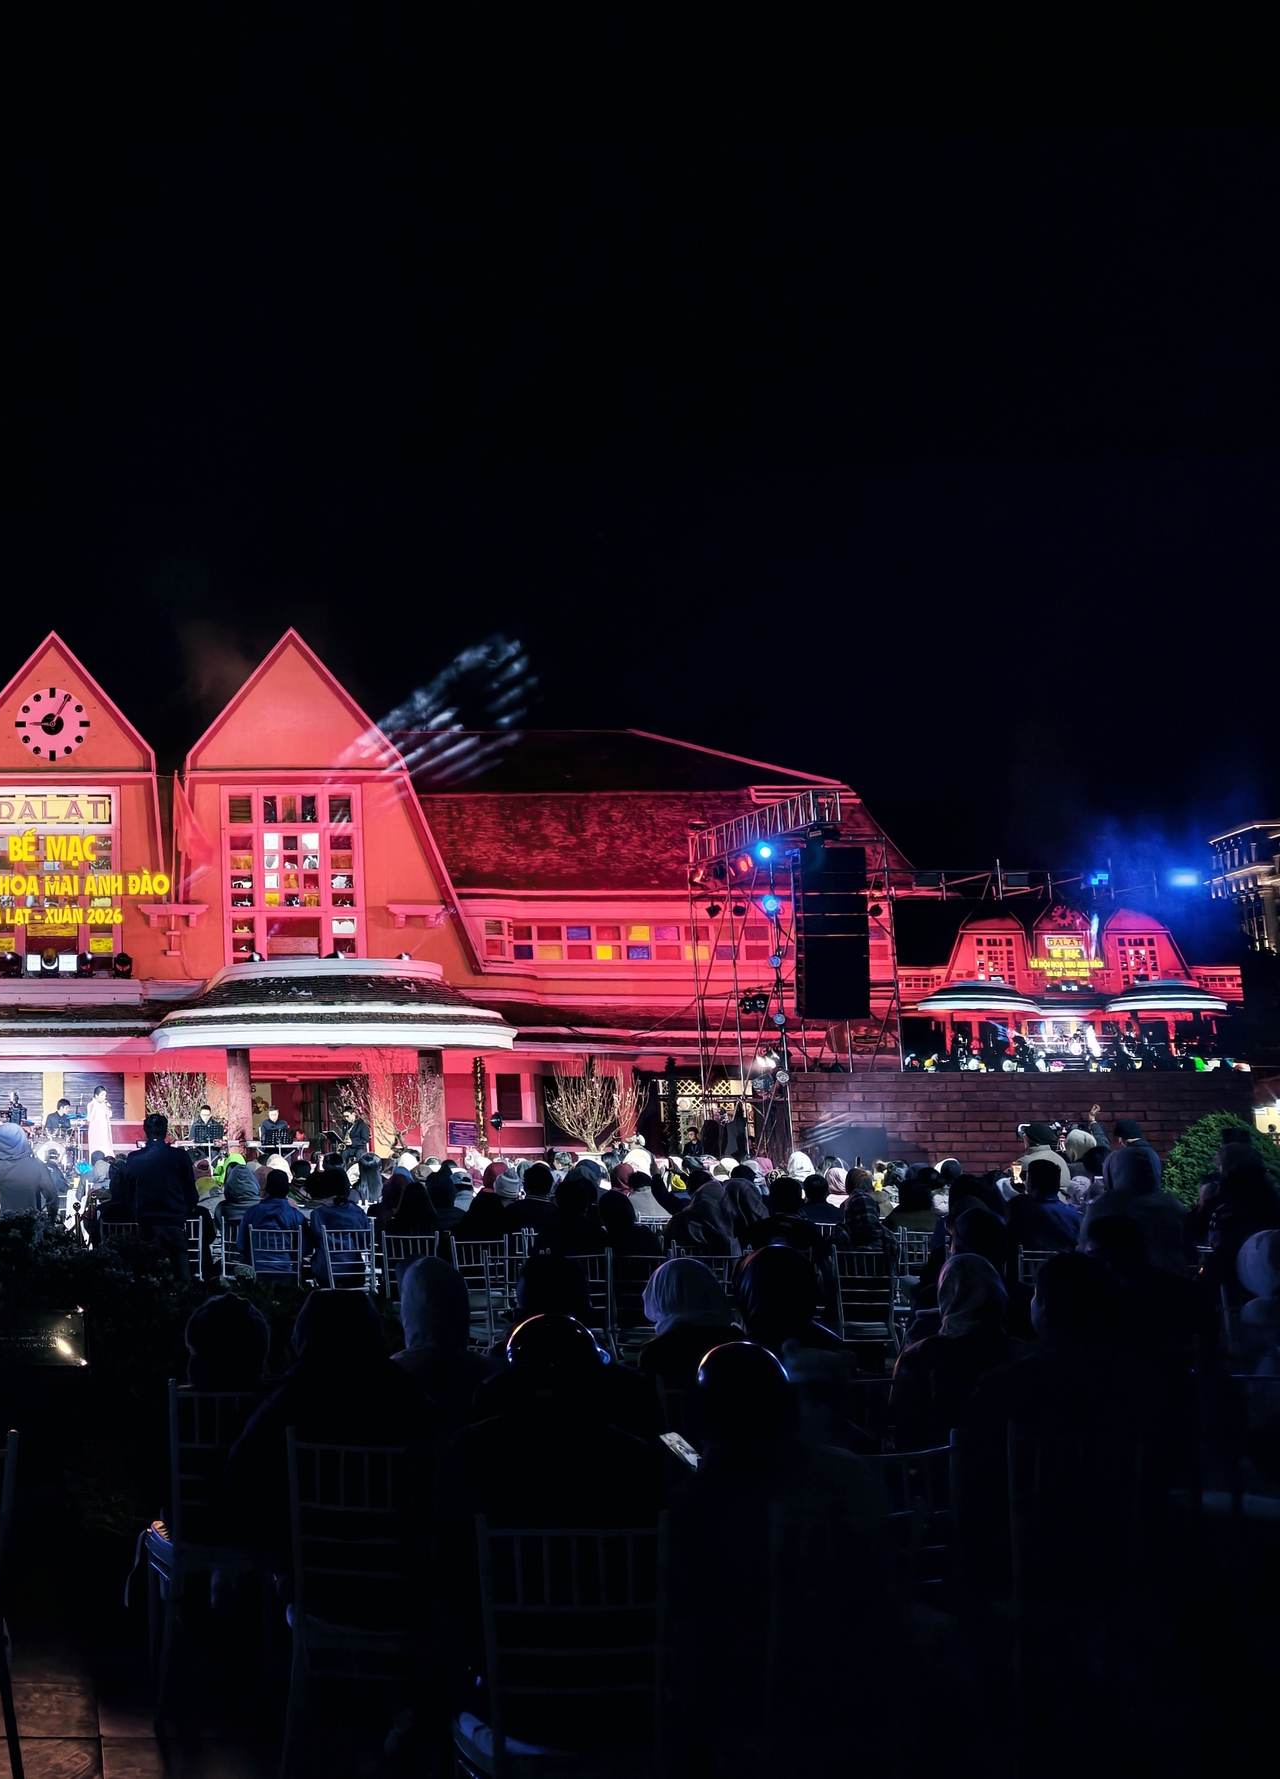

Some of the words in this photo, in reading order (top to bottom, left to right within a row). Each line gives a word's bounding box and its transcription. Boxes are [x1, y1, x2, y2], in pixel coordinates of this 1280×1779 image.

[8, 827, 37, 862] BẾ
[46, 834, 97, 867] MẠC
[44, 874, 79, 896] MAI
[84, 874, 122, 896] ANH
[127, 869, 170, 896] ĐÀO
[5, 907, 32, 926] LẠT
[44, 904, 83, 925] XUÂN
[86, 907, 123, 925] 2026
